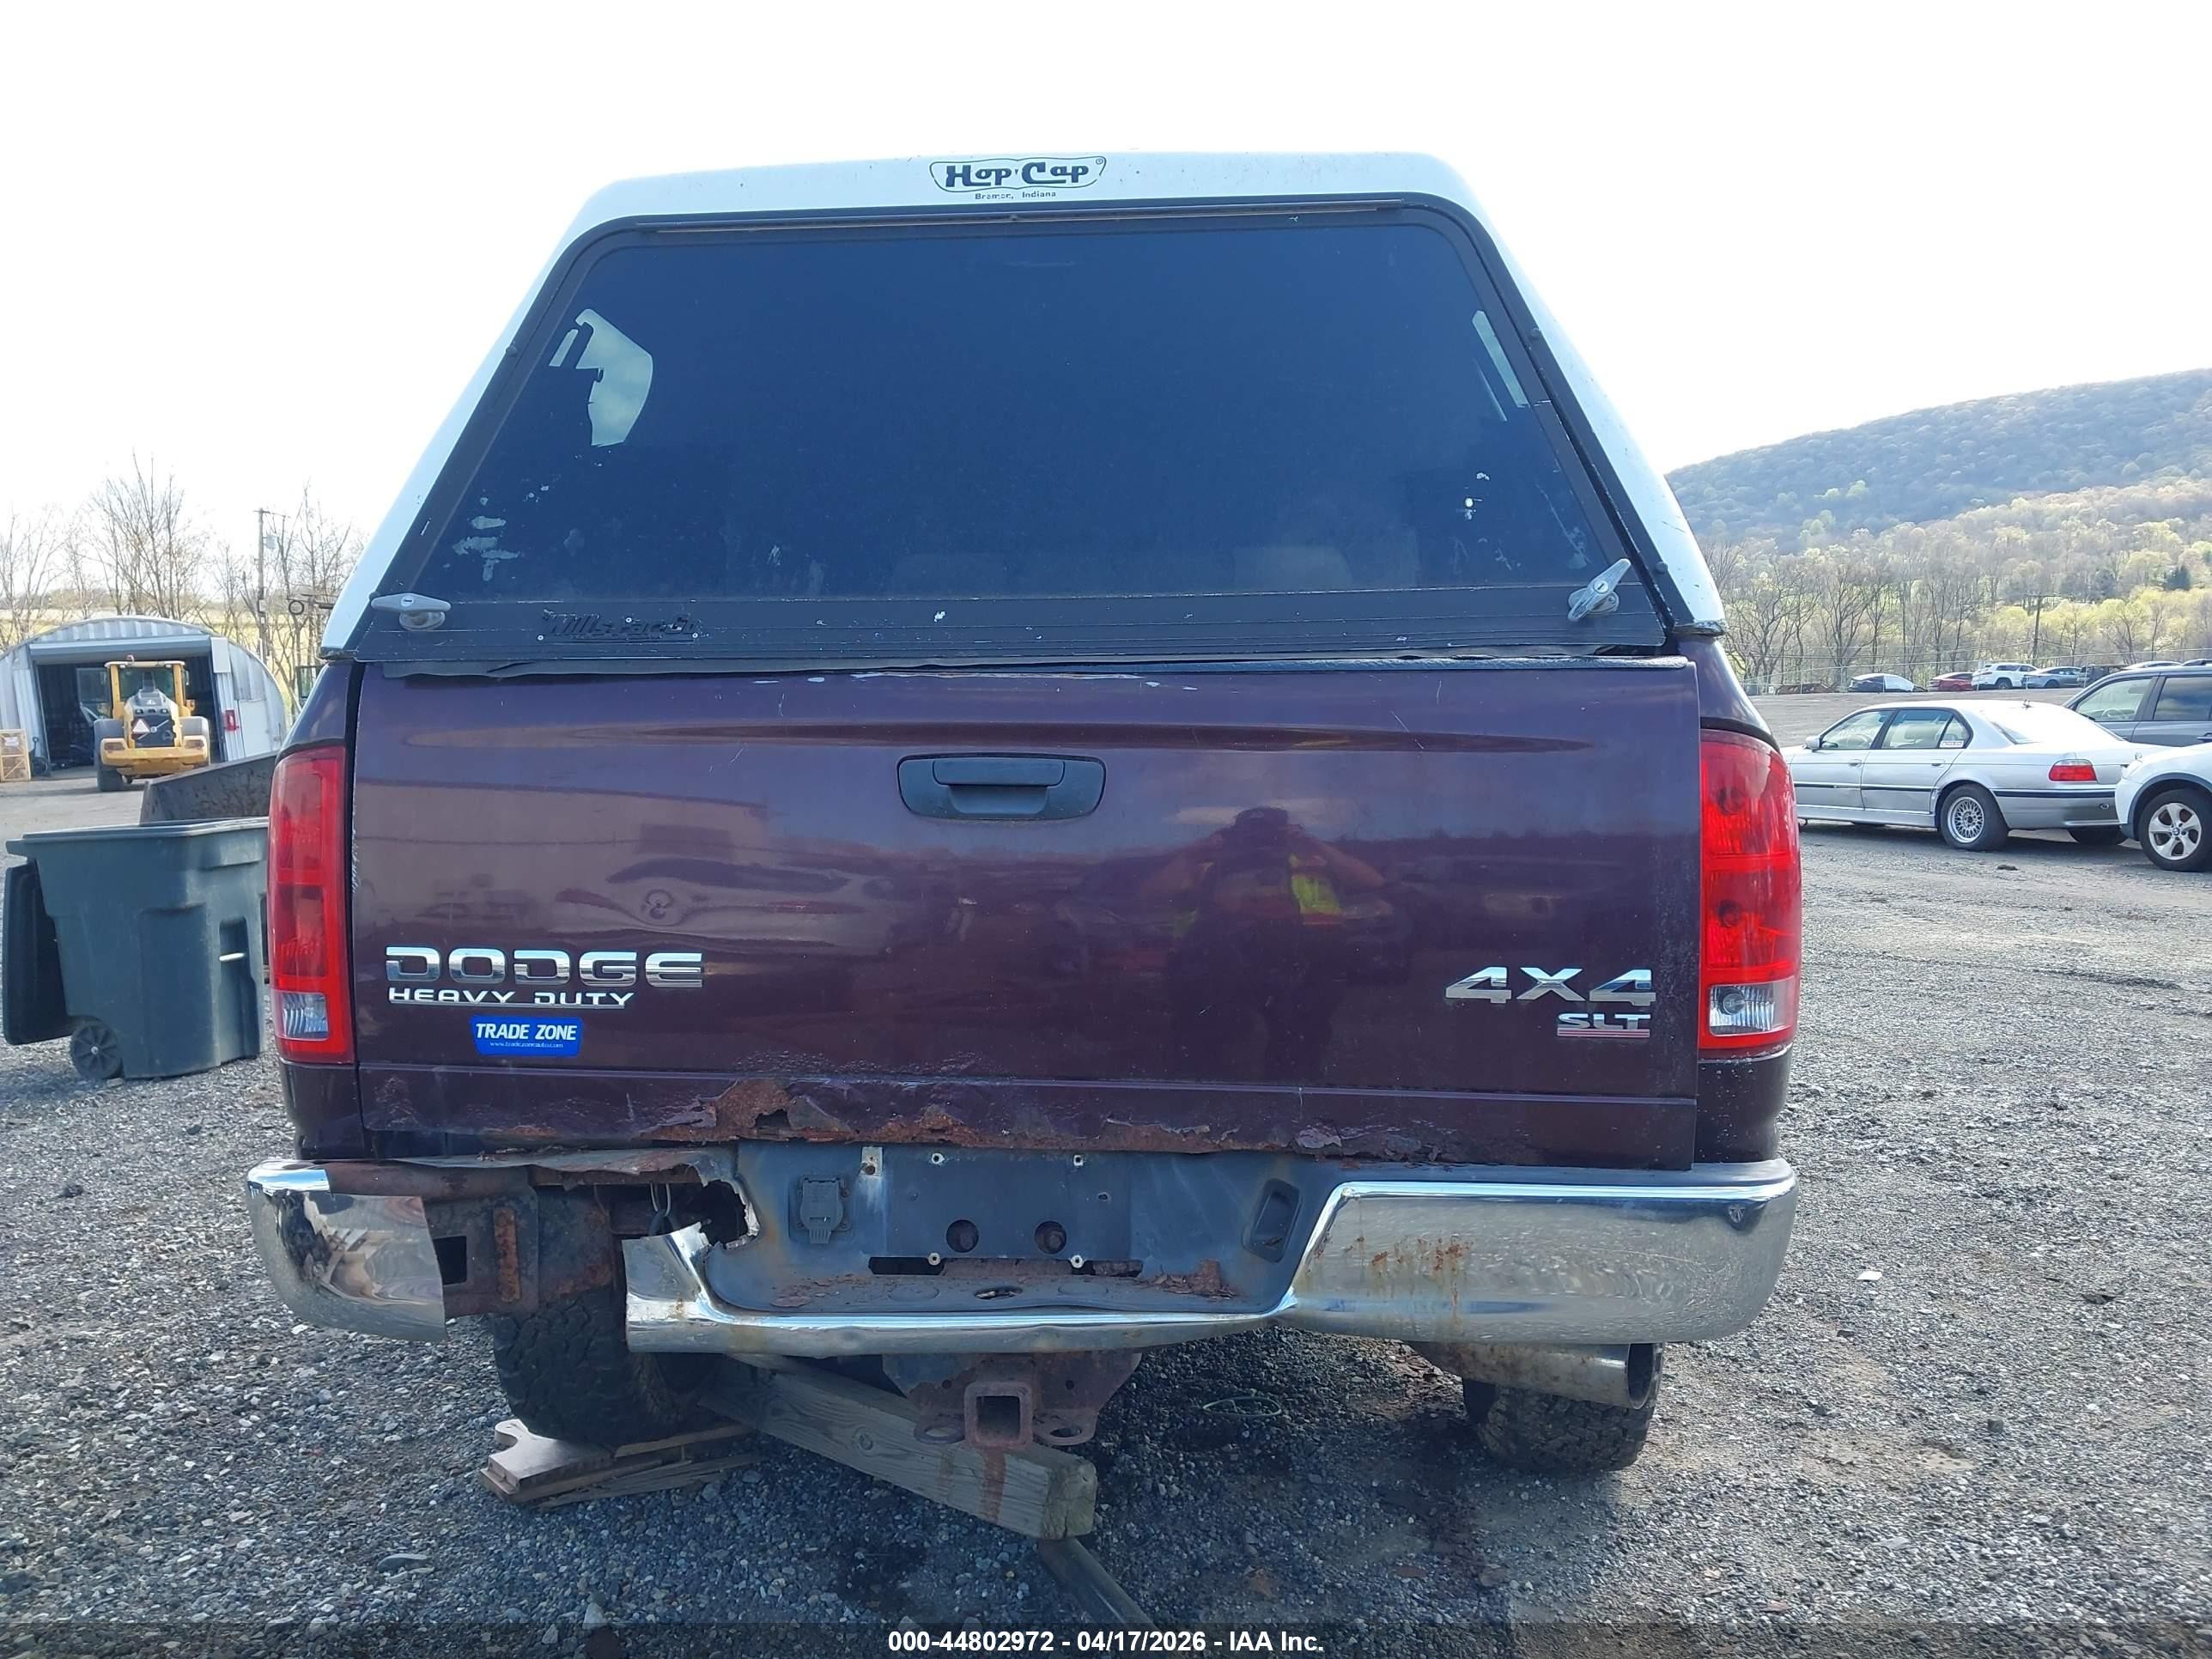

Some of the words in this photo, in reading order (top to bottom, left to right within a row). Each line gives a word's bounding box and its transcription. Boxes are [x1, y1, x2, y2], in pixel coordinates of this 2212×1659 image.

[1022, 190, 1056, 198] Indiana
[385, 945, 703, 988] DODGE
[389, 988, 515, 1004] HEAVY
[534, 992, 635, 1006] DUTY
[1558, 1012, 1651, 1030] SLT
[476, 1023, 531, 1040] TRADE
[534, 1024, 578, 1041] ZONE
